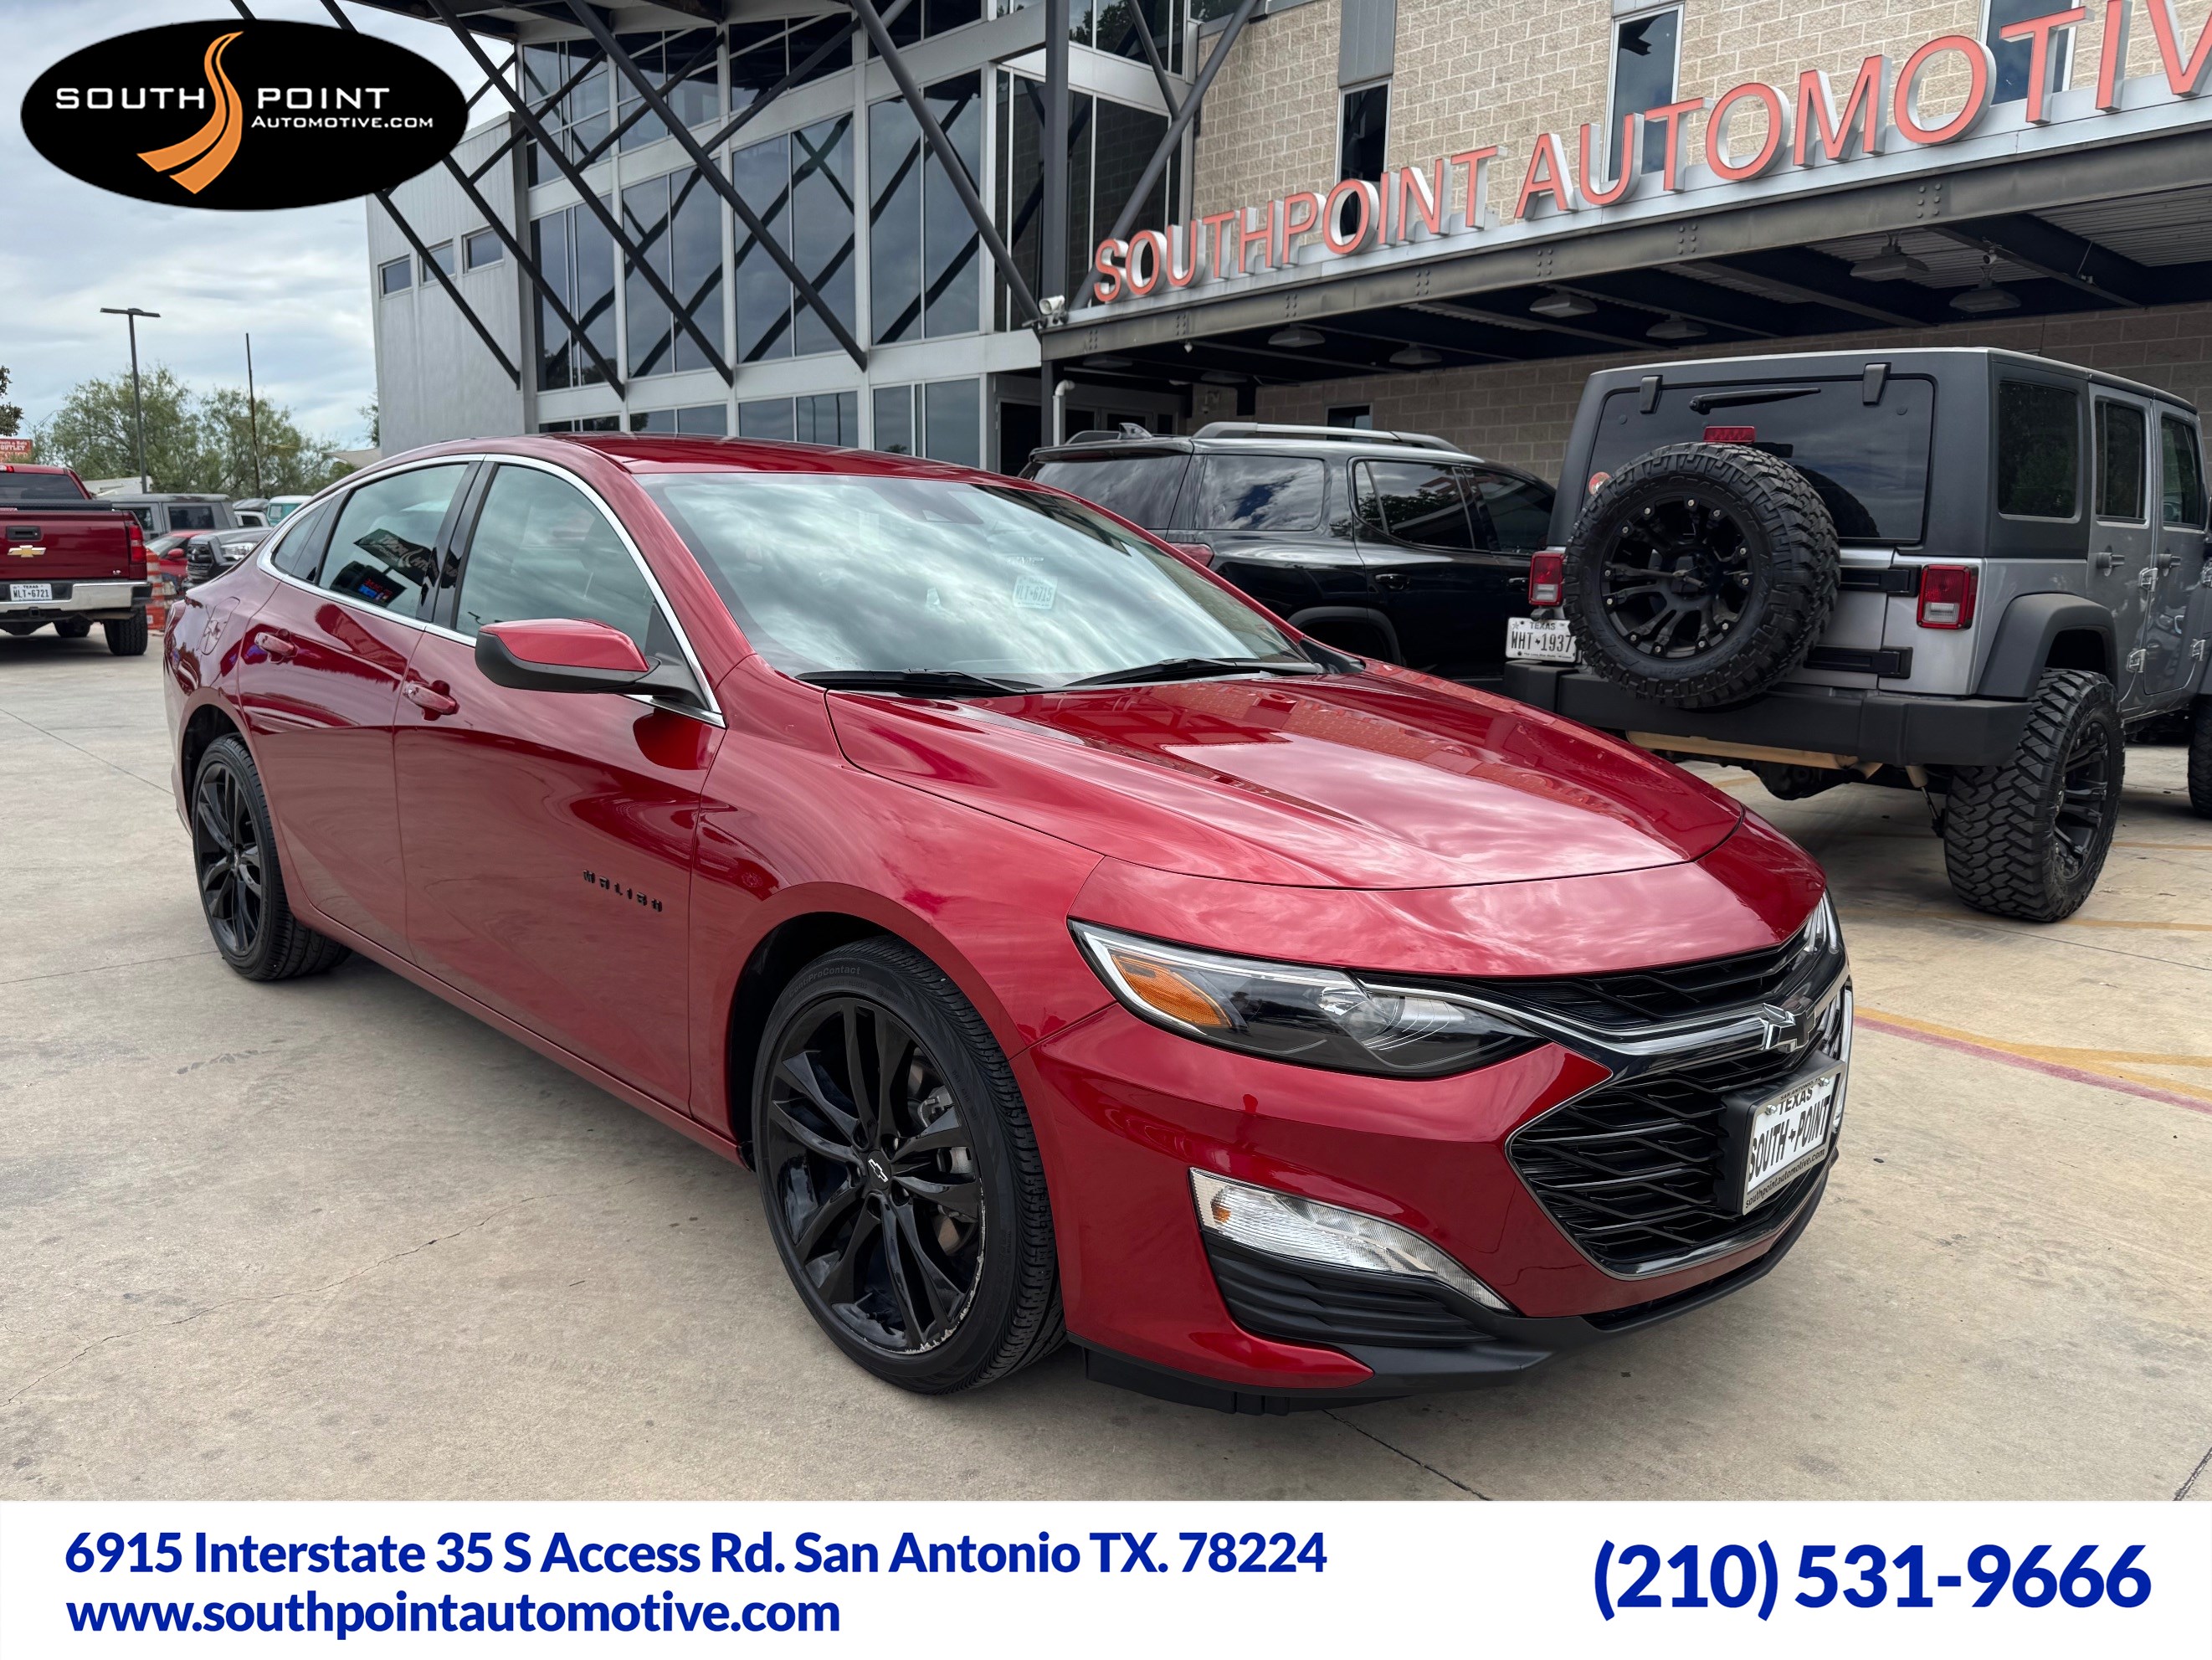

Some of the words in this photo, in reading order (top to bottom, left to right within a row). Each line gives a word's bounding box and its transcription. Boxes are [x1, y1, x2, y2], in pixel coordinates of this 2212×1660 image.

[1093, 145, 1508, 303] SOUTHPOINT
[1511, 630, 1533, 650] WHT
[1541, 633, 1573, 653] 1937
[1529, 621, 1556, 631] TEXAS
[1778, 1087, 1813, 1116] TEXAS
[1748, 1118, 1789, 1182] SOUTH
[1794, 1094, 1831, 1153] POINT
[1745, 1148, 1825, 1209] southpointautomotive.com
